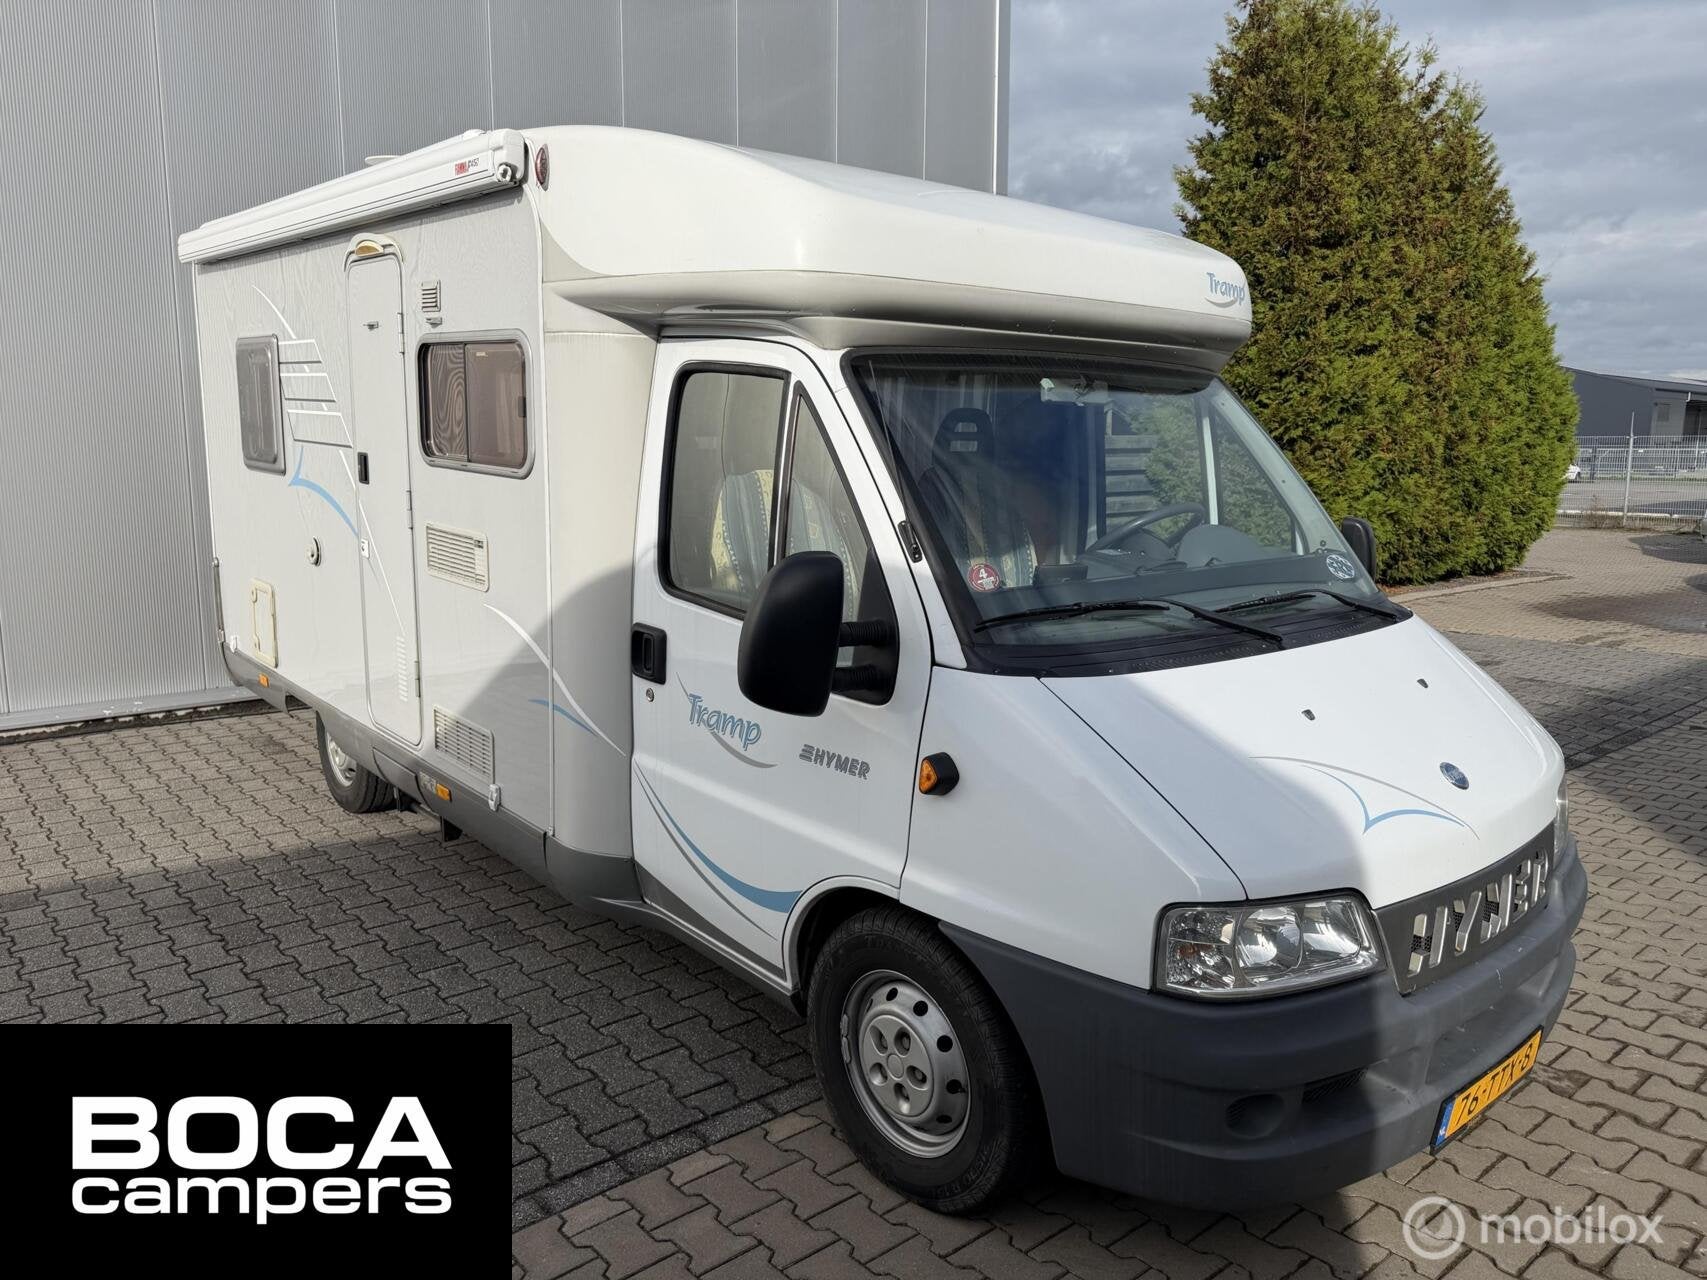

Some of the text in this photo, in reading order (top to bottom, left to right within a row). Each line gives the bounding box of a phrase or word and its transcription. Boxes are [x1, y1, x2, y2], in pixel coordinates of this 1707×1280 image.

[1206, 271, 1246, 306] Tramp
[688, 693, 762, 751] Tramp
[812, 747, 871, 780] HYMER
[1406, 849, 1549, 978] HYMER
[1455, 1042, 1533, 1126] 76-TTX-8
